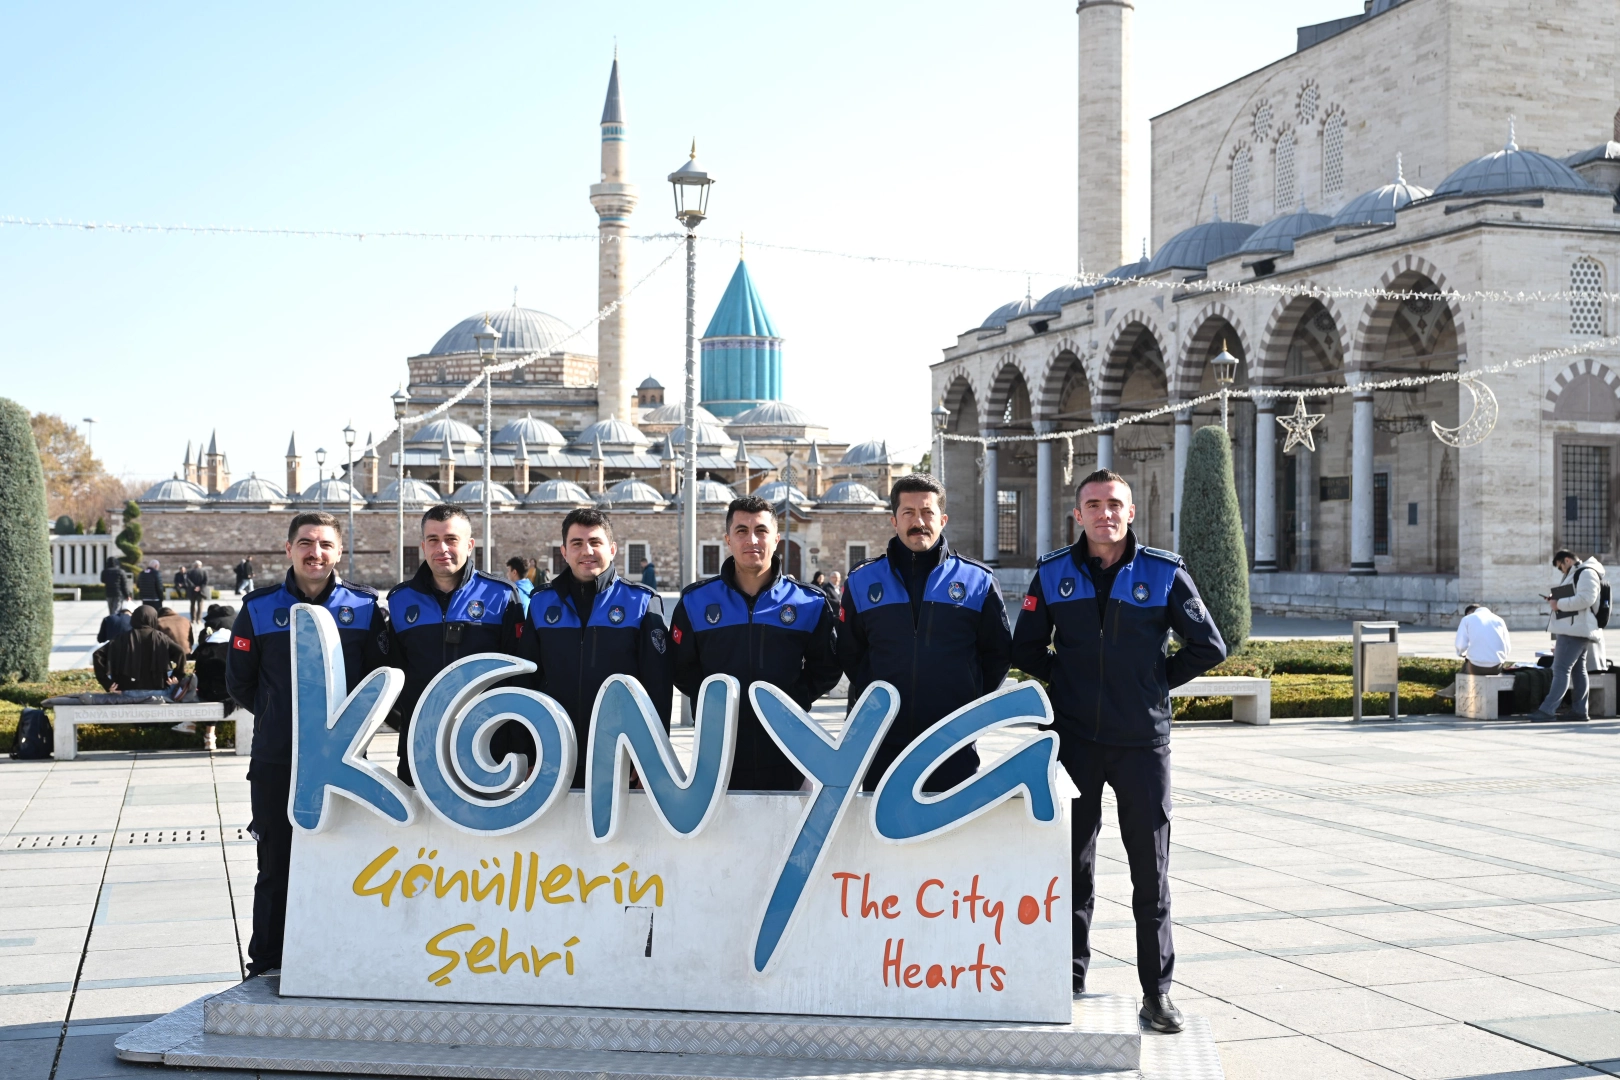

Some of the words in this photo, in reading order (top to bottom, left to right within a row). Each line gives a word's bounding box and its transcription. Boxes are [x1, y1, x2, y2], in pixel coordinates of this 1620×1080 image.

[75, 709, 109, 720] KONYA
[111, 706, 175, 719] BÜYÜKŞEHİR
[352, 846, 664, 912] Gönüllerin
[832, 872, 901, 919] The
[916, 874, 1004, 945] City
[1017, 876, 1060, 925] of
[425, 923, 580, 987] Şehri
[883, 938, 1006, 993] Hearts
